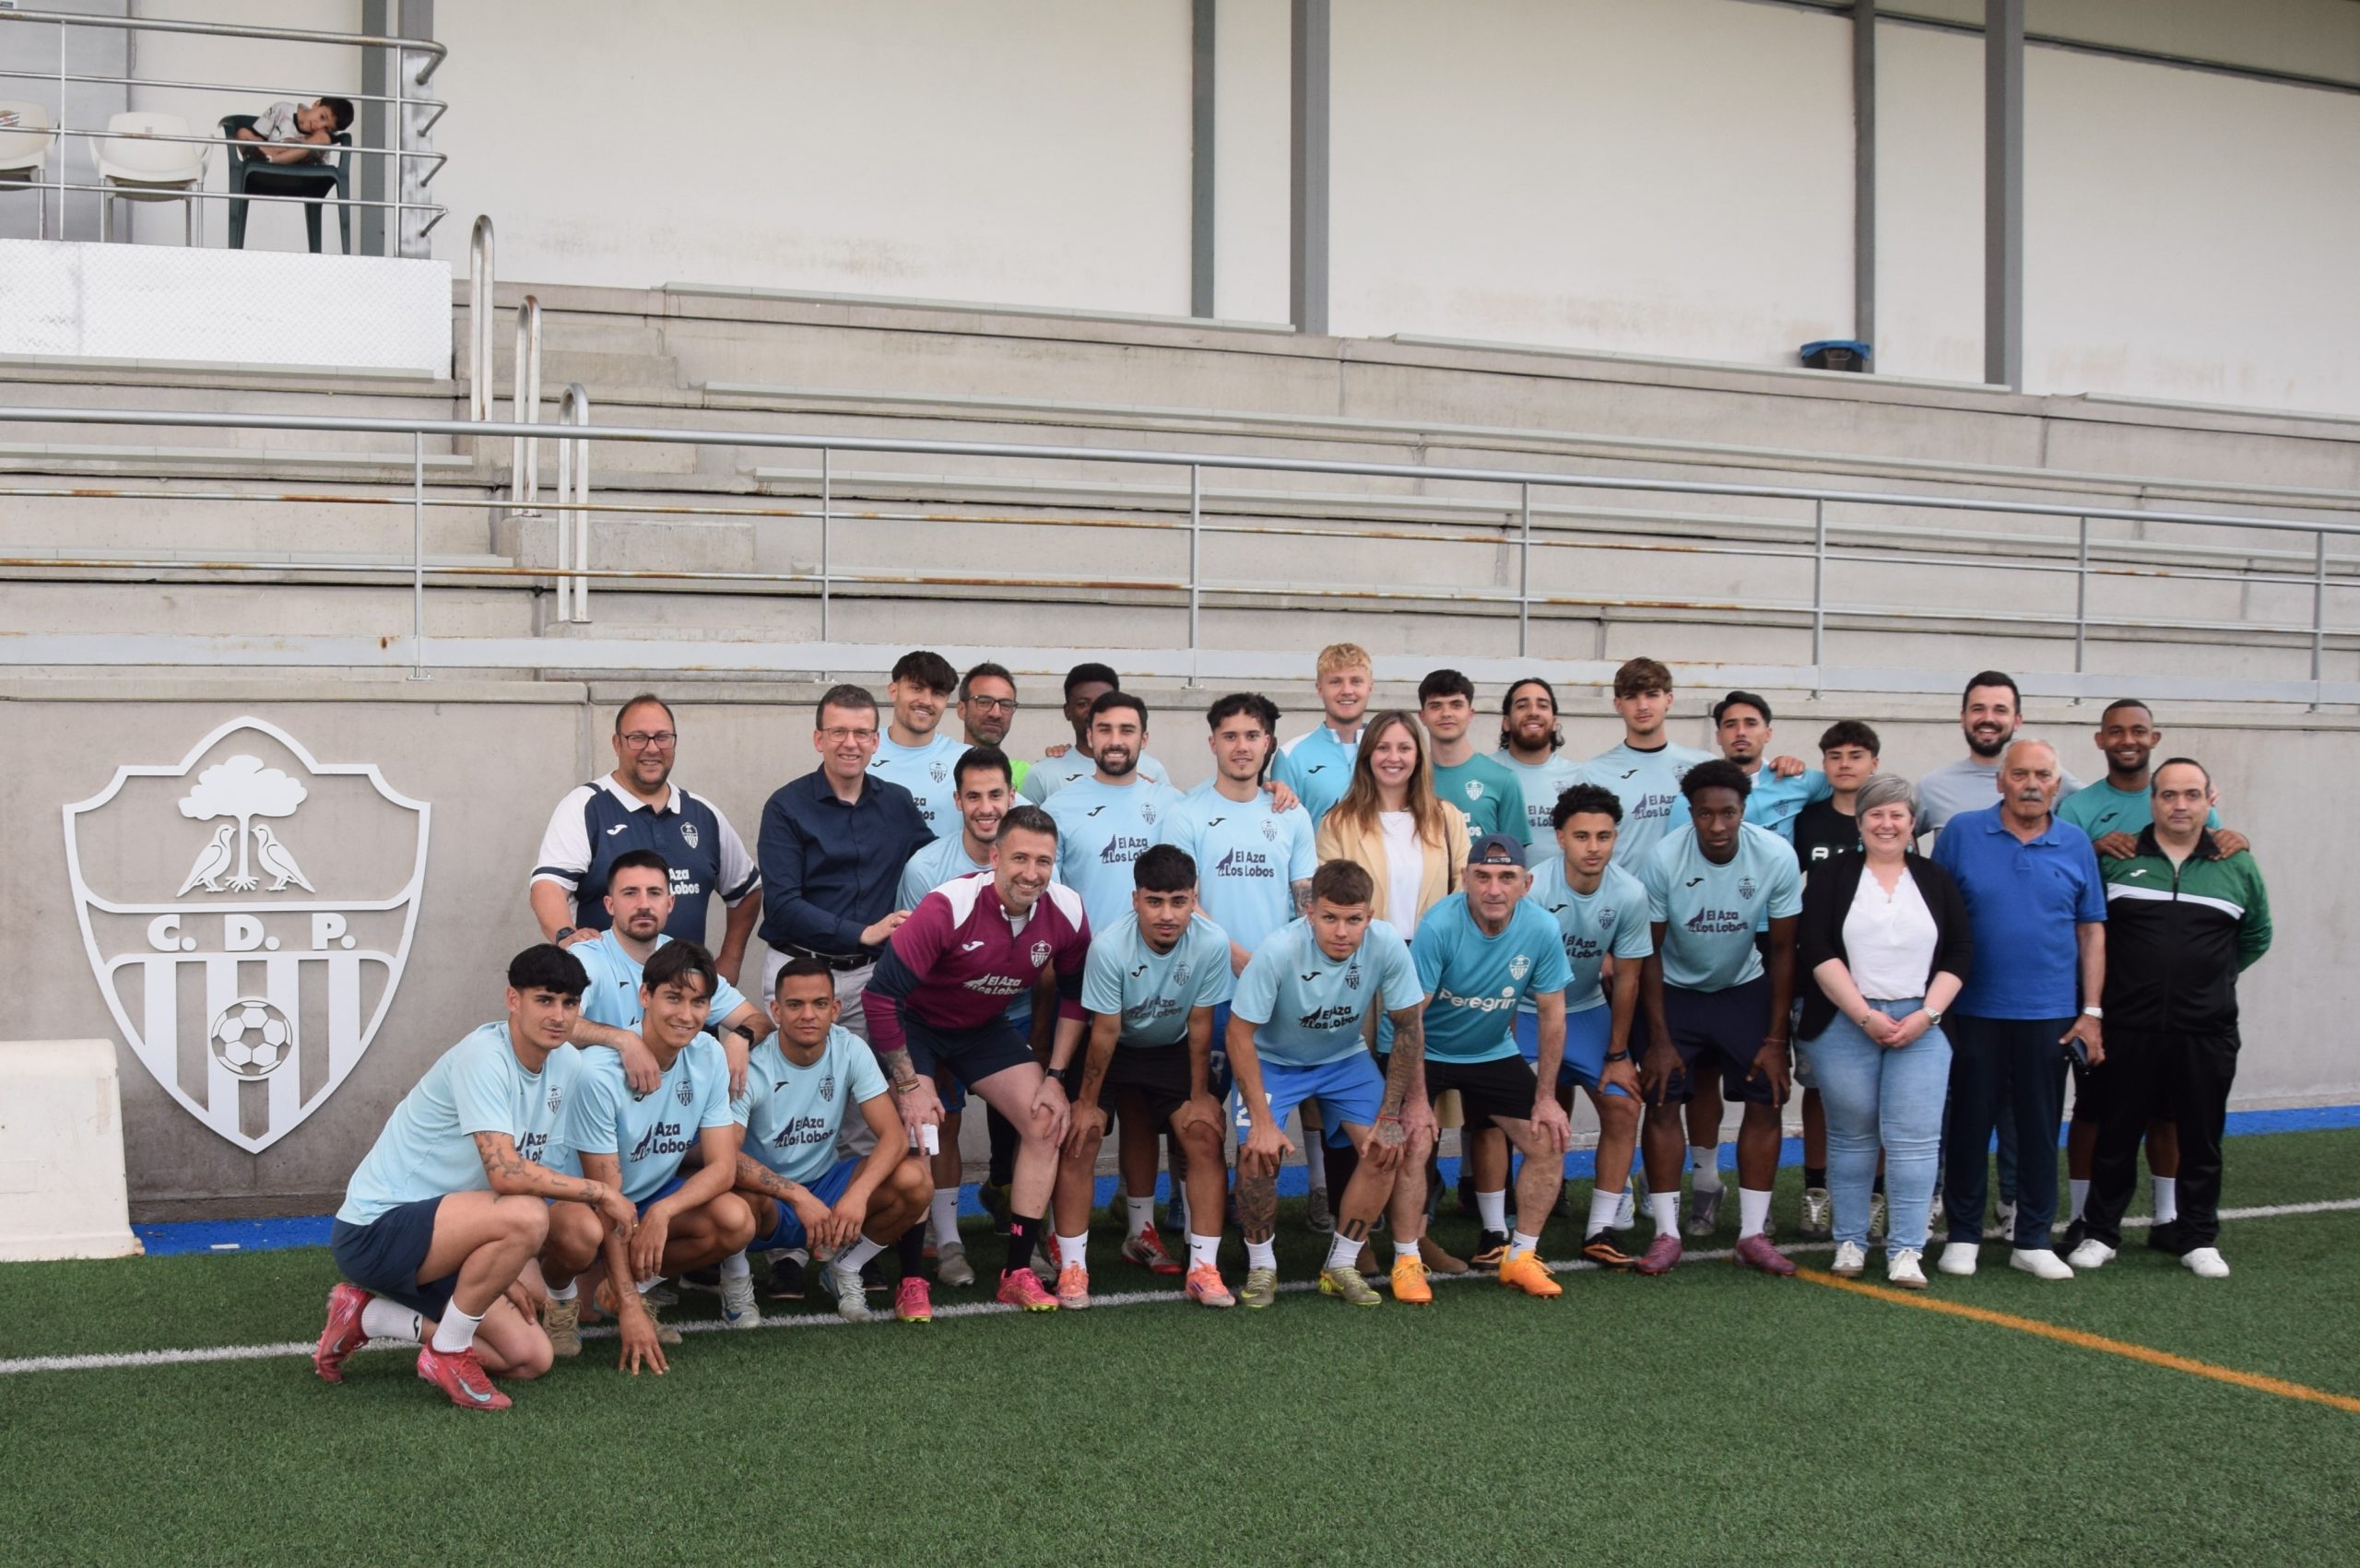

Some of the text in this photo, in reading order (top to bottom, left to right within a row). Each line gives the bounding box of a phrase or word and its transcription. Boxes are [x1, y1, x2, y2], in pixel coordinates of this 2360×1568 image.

[1649, 795, 1658, 806] El
[1528, 805, 1537, 816] El
[1118, 837, 1149, 849] El Aza
[1109, 851, 1127, 864] Los
[1235, 851, 1266, 864] El Aza
[668, 867, 690, 881] Aza
[1225, 864, 1275, 878] Los Lobos
[669, 881, 700, 895] Lobos
[1706, 910, 1739, 921] El Aza
[1696, 922, 1749, 933] Los Lobos
[1575, 937, 1597, 949] Aza
[986, 975, 1022, 986] El Aza
[1309, 1020, 1328, 1030] Los
[802, 1115, 825, 1129] Aza
[655, 1121, 680, 1138] Aza
[526, 1132, 548, 1147] Aza
